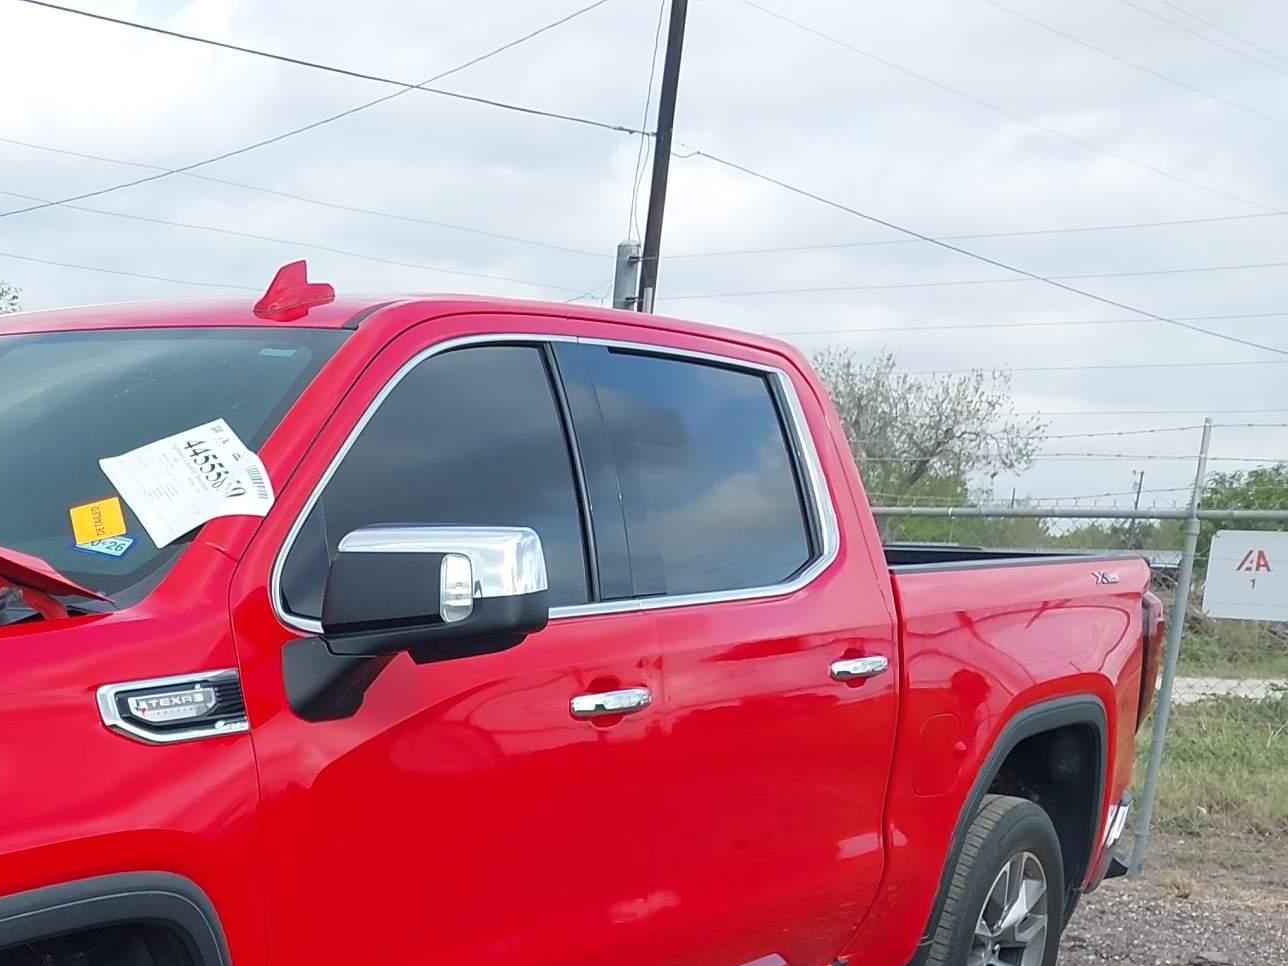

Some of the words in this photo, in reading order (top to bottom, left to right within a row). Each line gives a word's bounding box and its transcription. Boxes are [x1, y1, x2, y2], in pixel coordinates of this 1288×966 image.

[91, 506, 105, 537] DETAILED
[1249, 578, 1256, 590] 1
[148, 692, 205, 708] TEXAS
